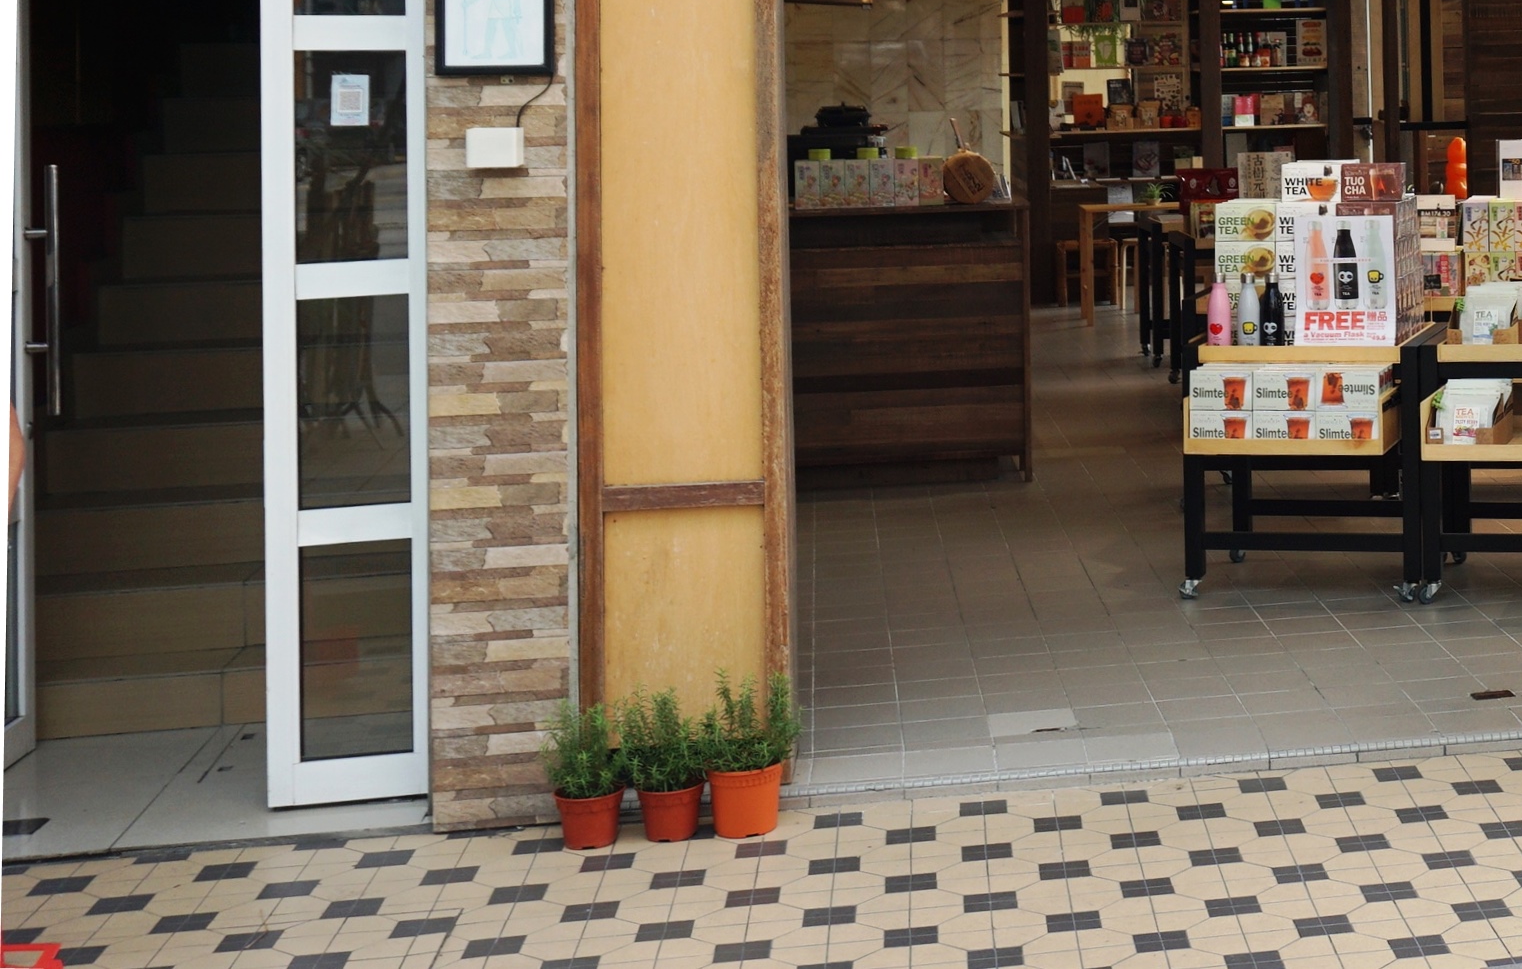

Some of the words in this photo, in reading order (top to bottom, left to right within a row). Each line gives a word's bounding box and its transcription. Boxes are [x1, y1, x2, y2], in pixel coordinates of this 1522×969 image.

[1284, 177, 1323, 186] WHITE
[1344, 176, 1365, 186] TUO
[1284, 186, 1307, 196] TEA
[1344, 185, 1366, 195] CHA
[1218, 216, 1255, 226] GREEN
[1218, 226, 1239, 235] TEA
[1218, 254, 1255, 264] GREEN
[1218, 264, 1239, 273] TEA
[1278, 264, 1296, 273] TE
[1475, 310, 1493, 319] TEA
[1304, 311, 1365, 331] FREE
[1343, 330, 1364, 338] Flask
[1192, 387, 1229, 399] Slimtee
[1255, 387, 1293, 399] Slimtee
[1337, 383, 1376, 396] Slimtee
[1456, 408, 1474, 417] TEA
[1192, 427, 1230, 439] Slimtee
[1255, 427, 1293, 439] Slimtee
[1318, 428, 1357, 440] Slimtee
